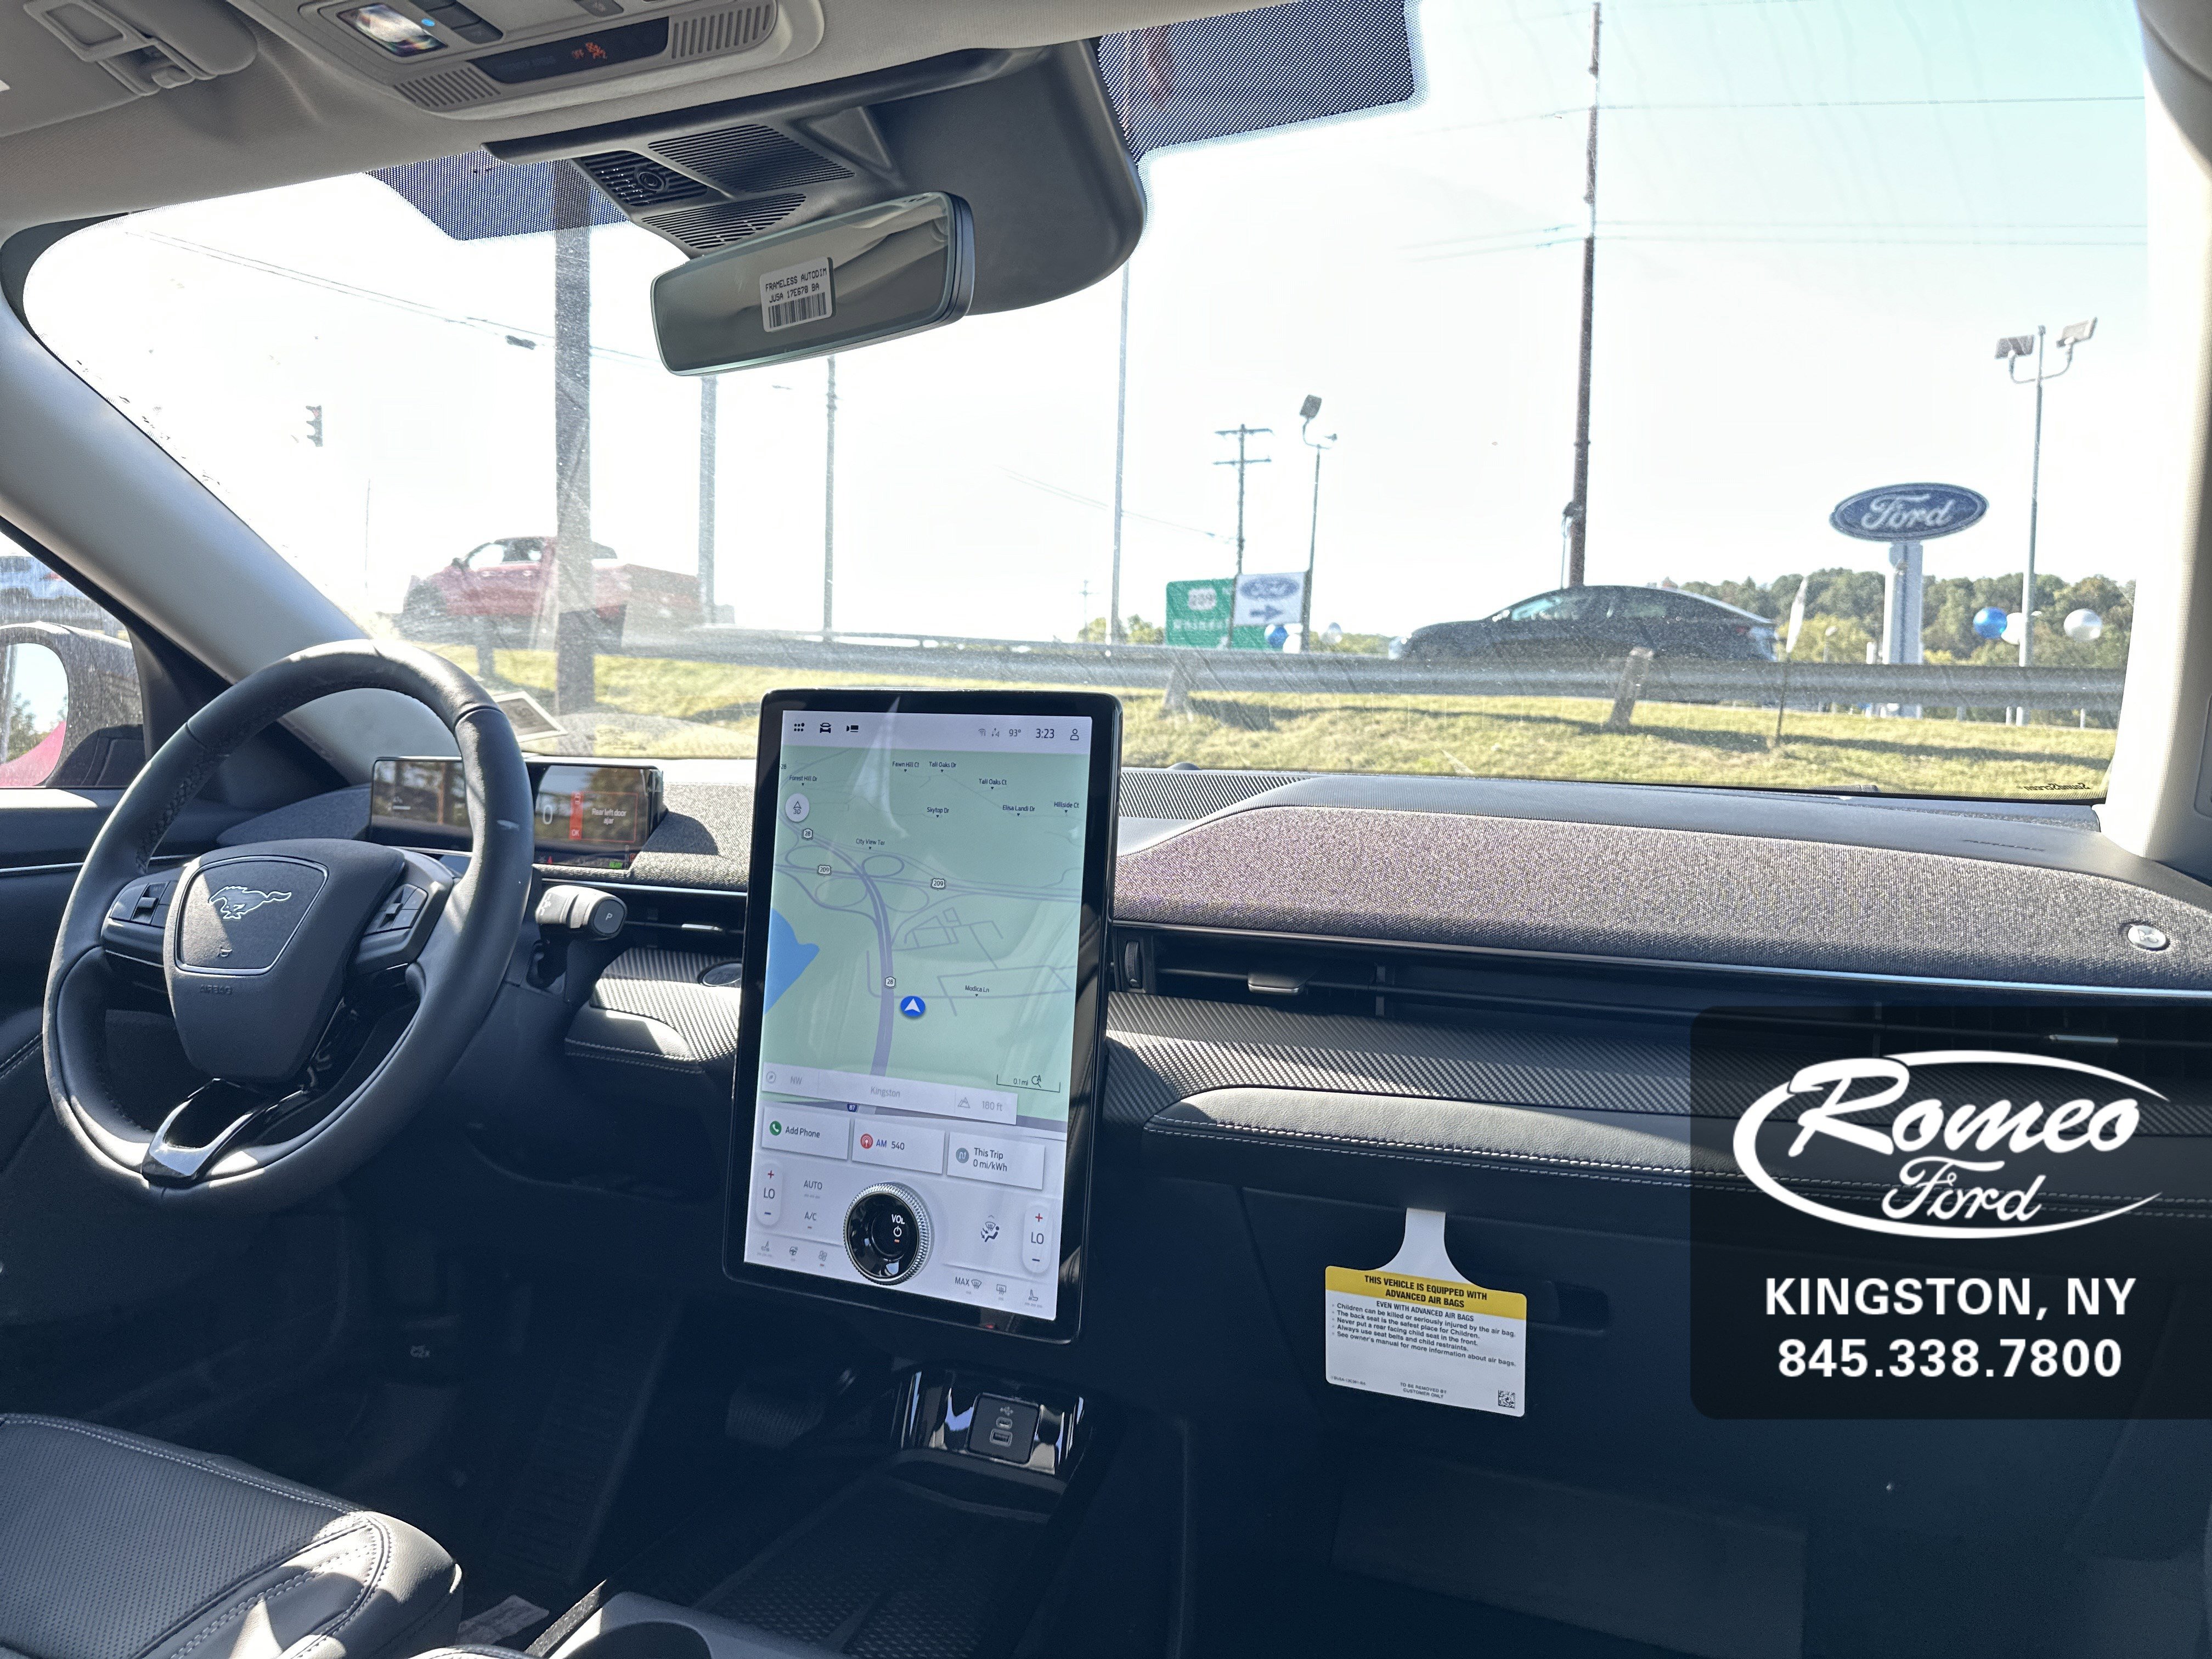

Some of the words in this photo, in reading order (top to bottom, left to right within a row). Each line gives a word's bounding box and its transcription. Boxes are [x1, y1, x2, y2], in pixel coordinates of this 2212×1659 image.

[766, 276, 798, 291] FRAMELESS
[801, 268, 827, 282] AUTODIM
[787, 286, 808, 298] 17E678
[812, 283, 819, 291] BA
[1861, 493, 1955, 529] Ford
[1036, 729, 1054, 738] 3:23
[543, 804, 553, 825] 0
[603, 817, 614, 825] ajar
[791, 1076, 802, 1085] NW
[870, 1086, 900, 1097] Kingston
[983, 1101, 994, 1110] 180
[997, 1103, 1002, 1111] ft
[786, 1126, 798, 1135] Add
[800, 1128, 820, 1138] Phone
[876, 1139, 887, 1148] AM
[891, 1141, 905, 1150] 540
[974, 1148, 988, 1157] This
[990, 1150, 1003, 1160] Trip
[979, 1161, 1007, 1172] mi/kWh
[804, 1180, 822, 1189] AUTO
[764, 1188, 775, 1199] LO
[804, 1211, 817, 1221] A/C
[891, 1214, 905, 1224] VOL
[1031, 1232, 1043, 1244] LO
[955, 1277, 969, 1286] MAX
[1364, 1276, 1381, 1284] THIS
[1384, 1278, 1414, 1289] VEHICLE
[1427, 1285, 1464, 1296] EQUIPPED
[1467, 1290, 1487, 1300] WITH
[1385, 1289, 1426, 1302] ADVANCED
[1428, 1296, 1441, 1304] AIR
[1444, 1299, 1464, 1307] BAGS
[1337, 1303, 1363, 1312] Children
[1414, 1317, 1443, 1326] seriously
[1445, 1320, 1468, 1329] injured
[1411, 1307, 1443, 1317] ADVANCED
[1400, 1320, 1419, 1328] safest
[1337, 1324, 1359, 1333] Always
[1389, 1332, 1403, 1340] belts
[1387, 1326, 1407, 1335] facing
[1409, 1328, 1424, 1336] child
[1350, 1334, 1374, 1342] owner's
[1429, 1347, 1465, 1358] information
[1403, 1388, 1430, 1396] CUSTOMER
[1415, 1385, 1439, 1393] REMOVED
